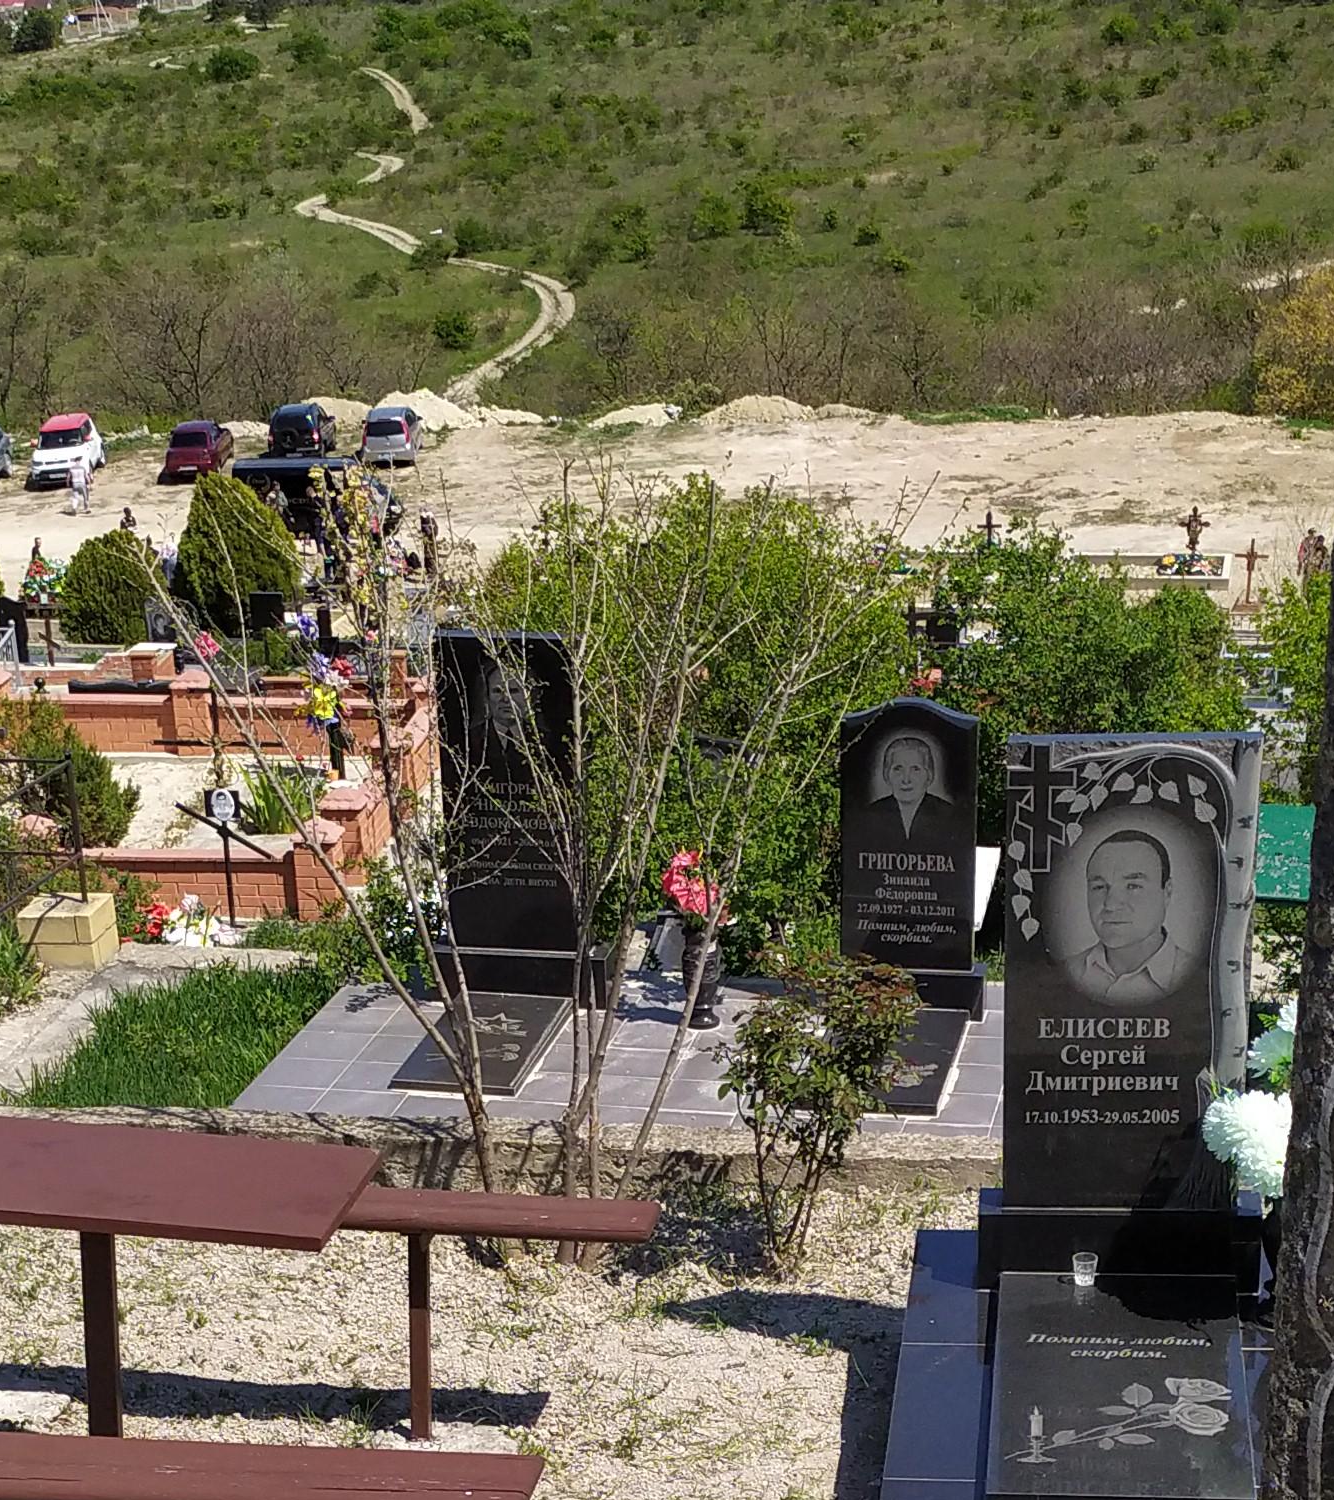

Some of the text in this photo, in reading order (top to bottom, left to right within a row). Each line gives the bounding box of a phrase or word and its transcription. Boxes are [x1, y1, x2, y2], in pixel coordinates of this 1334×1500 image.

[858, 852, 956, 872] ГРИГОРЬЕВА
[882, 873, 931, 886] Зинаида
[1037, 1017, 1171, 1039] ЕЛИСЕЕВ
[1060, 1044, 1146, 1070] Сергей
[1025, 1070, 1180, 1096] Дмитриевич
[1027, 1333, 1212, 1347] Помним, любим,
[1070, 1348, 1167, 1360] скорбим.
